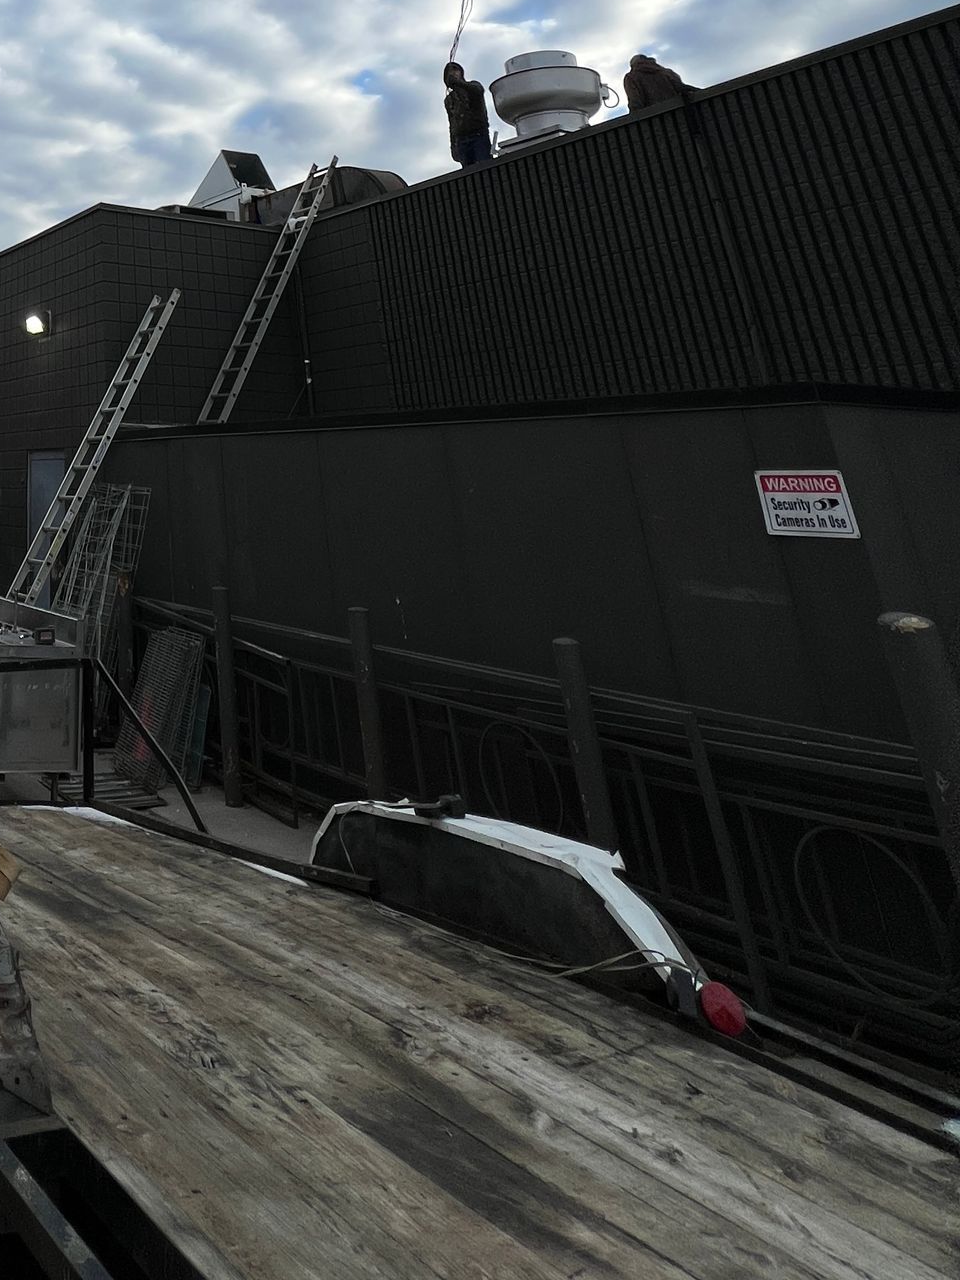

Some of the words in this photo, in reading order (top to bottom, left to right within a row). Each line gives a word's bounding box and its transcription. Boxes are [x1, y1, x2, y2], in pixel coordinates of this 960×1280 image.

[764, 477, 837, 491] WARNING
[770, 497, 810, 513] Security
[775, 514, 815, 528] Cameras
[816, 515, 828, 528] In
[828, 515, 847, 529] Use
